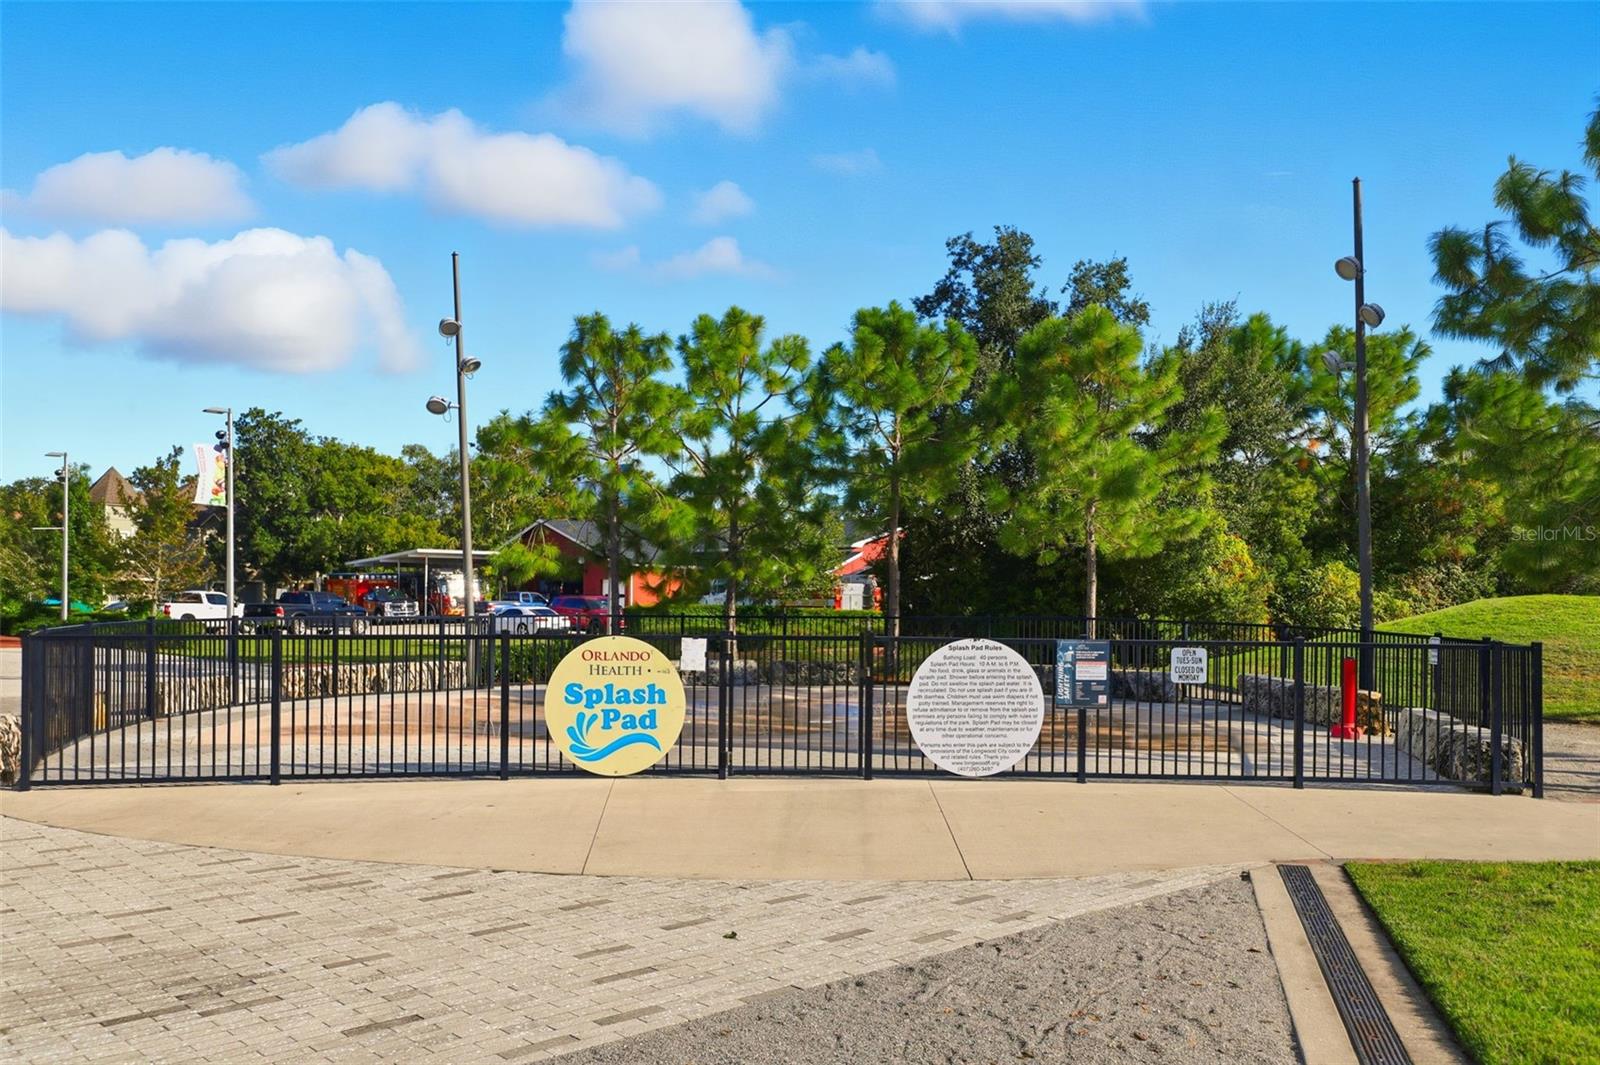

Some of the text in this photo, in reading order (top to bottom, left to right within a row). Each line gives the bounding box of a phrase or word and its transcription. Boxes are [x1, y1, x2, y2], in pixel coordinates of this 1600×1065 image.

[582, 650, 650, 661] ORLANDO
[590, 665, 642, 676] HEALTH
[564, 683, 666, 709] Splash
[601, 709, 657, 730] Pad
